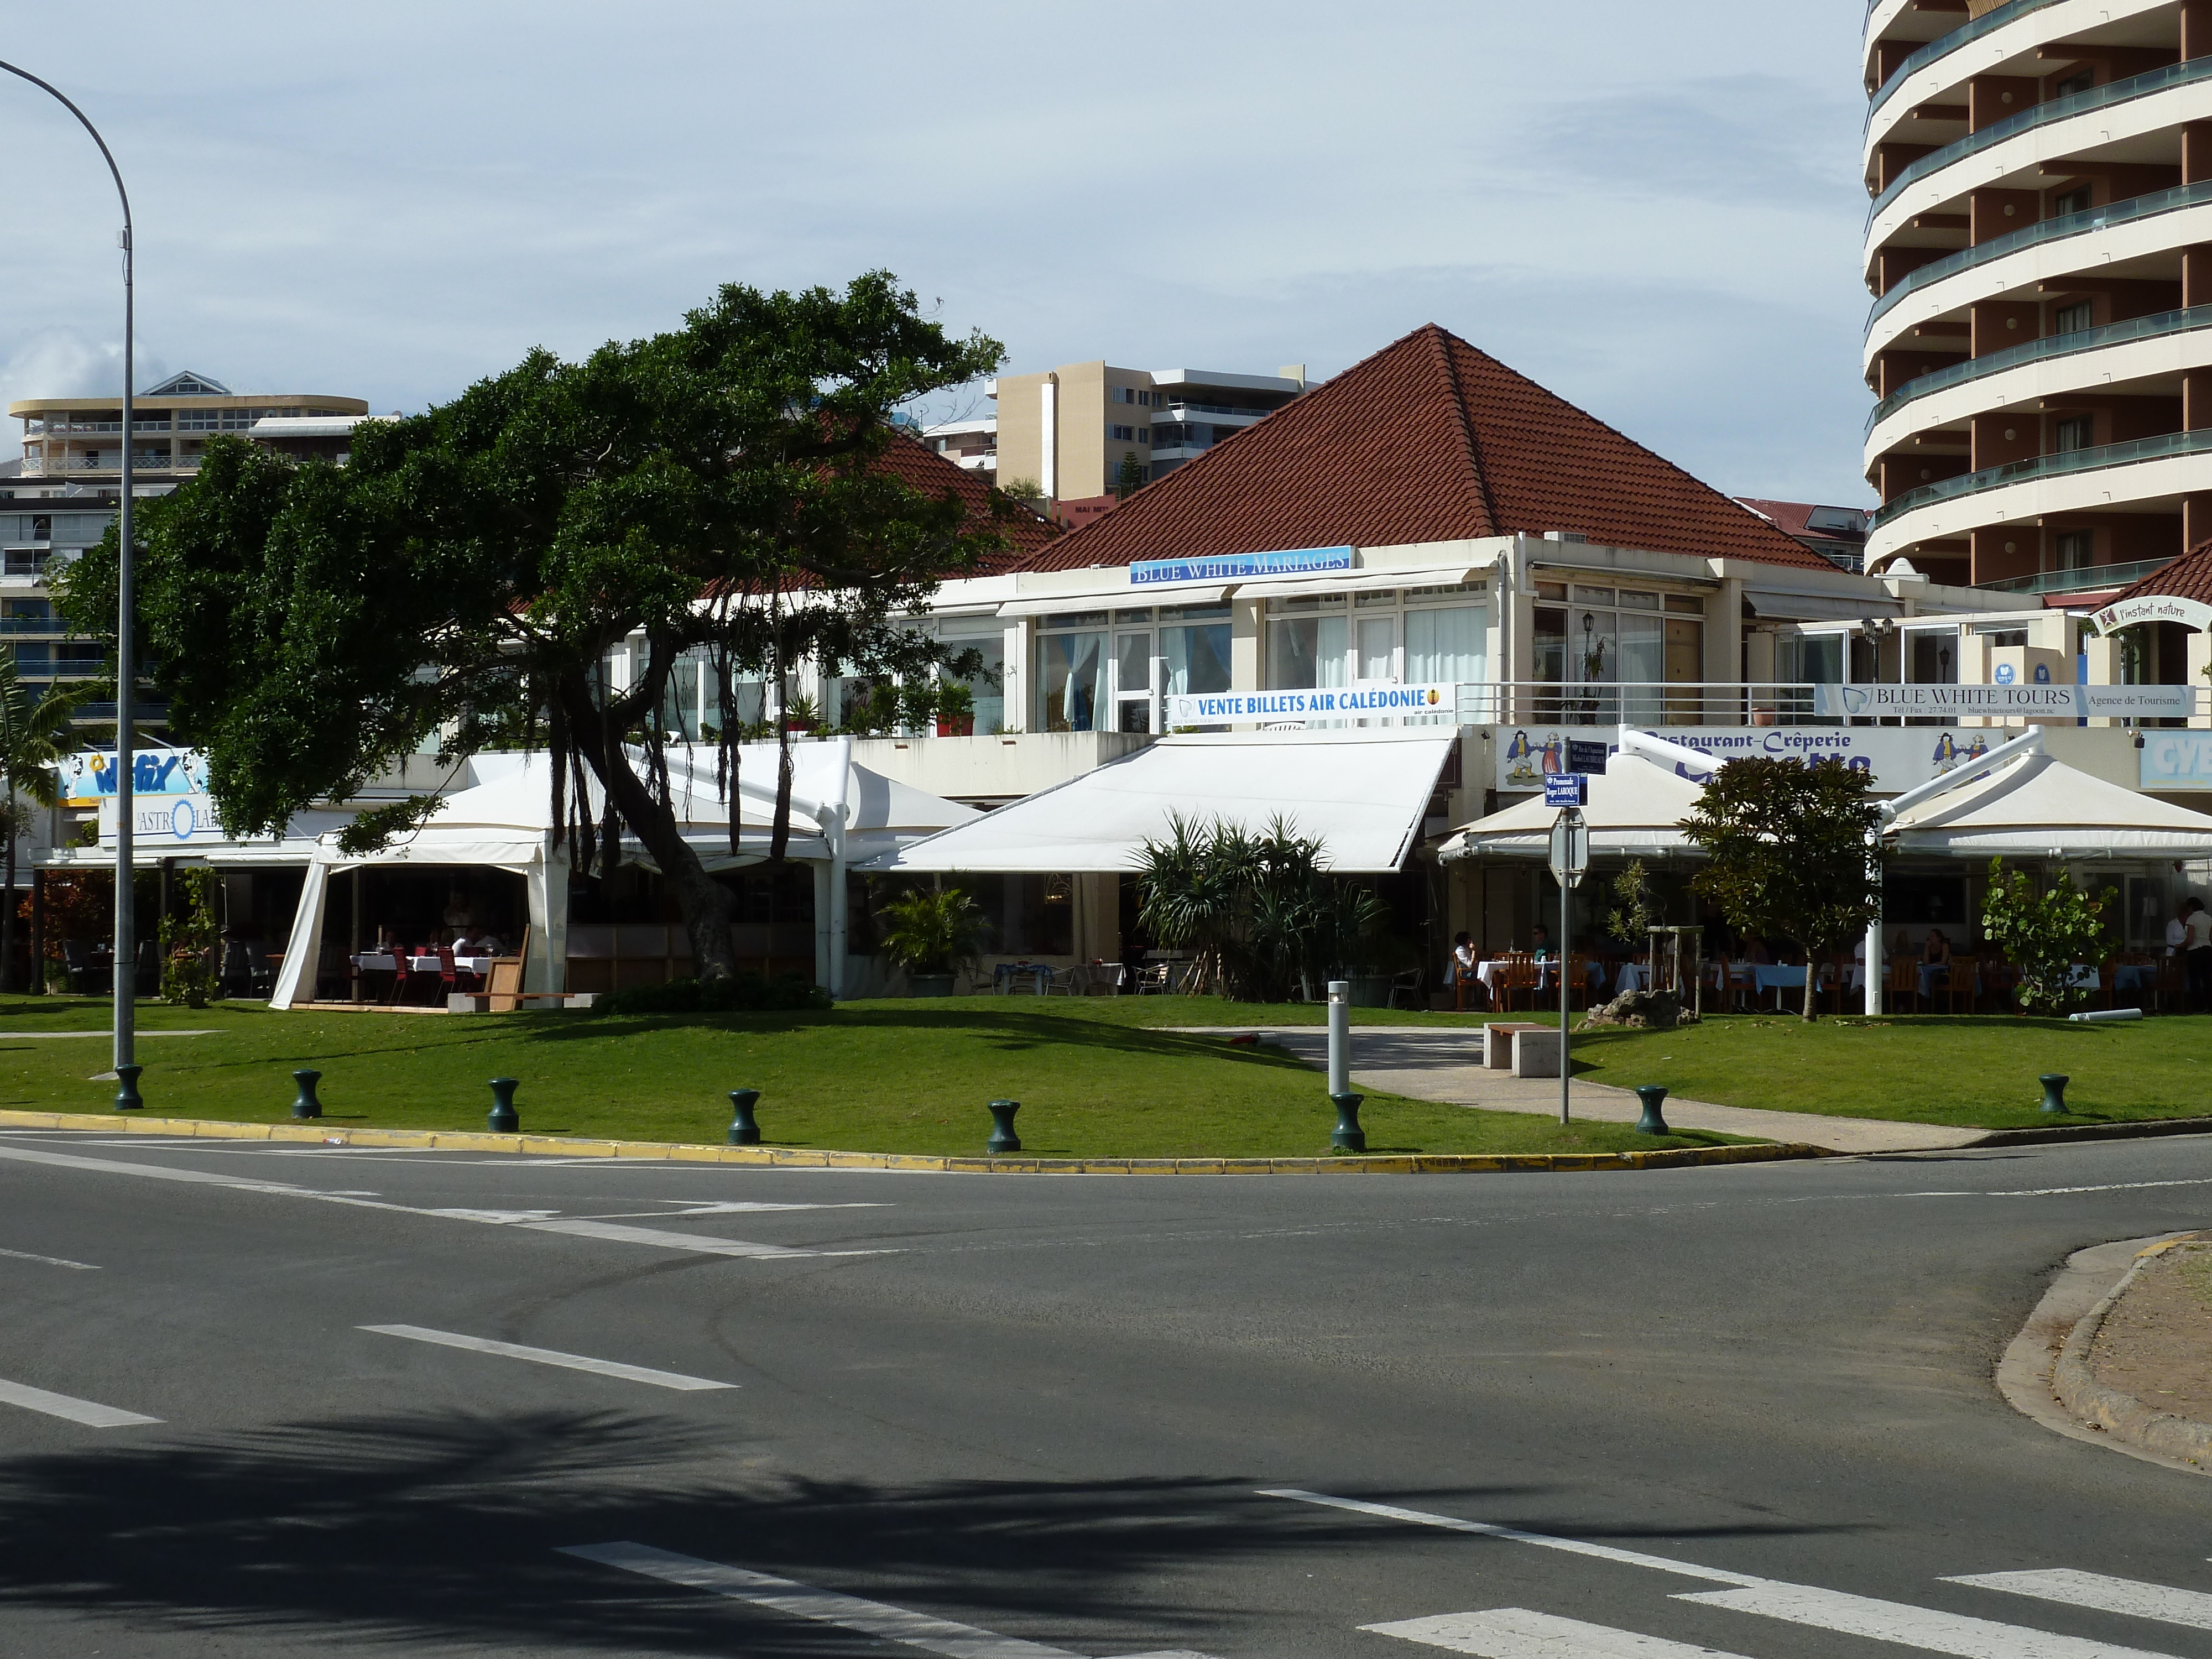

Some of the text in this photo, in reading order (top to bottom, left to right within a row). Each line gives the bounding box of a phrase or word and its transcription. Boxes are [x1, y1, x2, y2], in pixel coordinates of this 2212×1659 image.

[1136, 552, 1345, 582] BLUE WHITE MARIAGES
[2120, 602, 2185, 620] l'instant nature
[1198, 687, 1425, 715] VENTE BILLETS AIR CALÉDONIE
[1877, 688, 2070, 705] BLUE WHITE TOURS
[2089, 696, 2180, 707] Agence de Tourisme
[1968, 707, 2055, 715] bluewhitetours@lagoon.nc
[1553, 777, 1573, 785] Promenade
